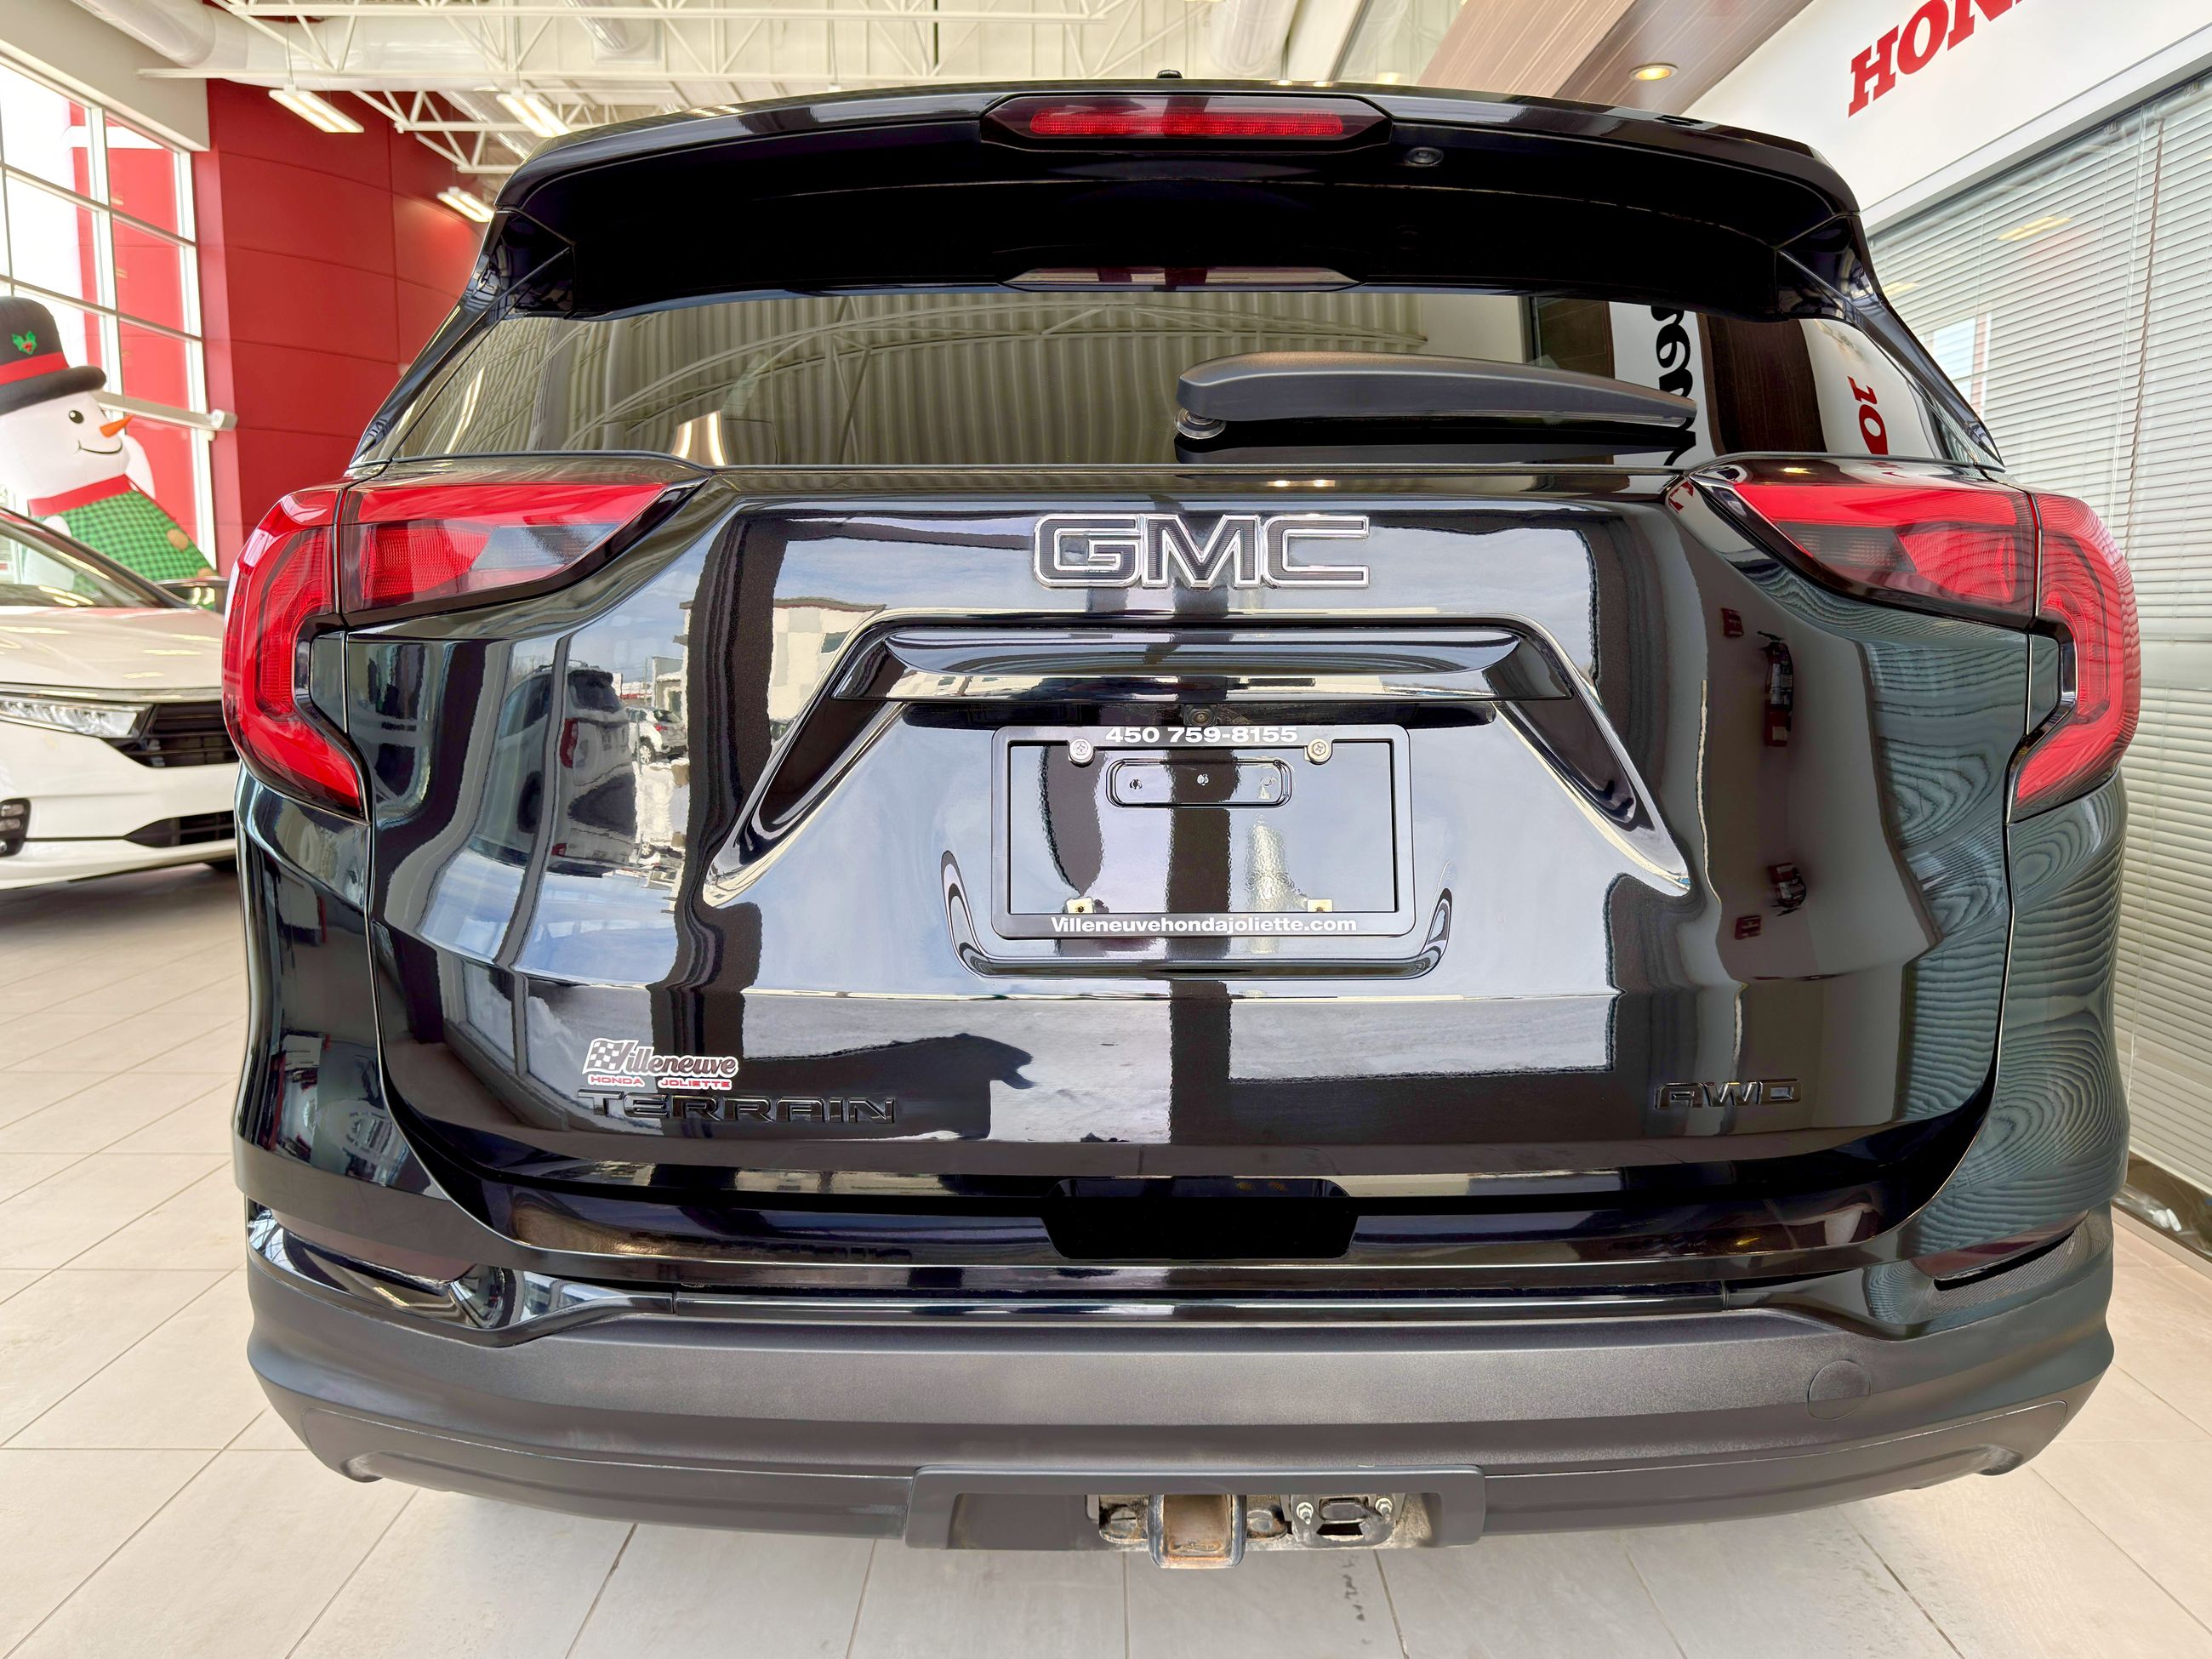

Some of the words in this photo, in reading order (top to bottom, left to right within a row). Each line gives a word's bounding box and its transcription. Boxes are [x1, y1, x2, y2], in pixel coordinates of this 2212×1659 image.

[1034, 513, 1371, 590] GMC
[1106, 727, 1160, 743] 450
[1167, 727, 1297, 743] 759-8155
[1051, 917, 1357, 935] Villeneuvehondajoliette.com
[584, 1039, 737, 1075] Villeneuve
[590, 1076, 644, 1085] HONDA
[660, 1080, 732, 1088] JOLIETTE
[1654, 1078, 1801, 1109] AWD
[578, 1089, 896, 1124] TERRAIN
